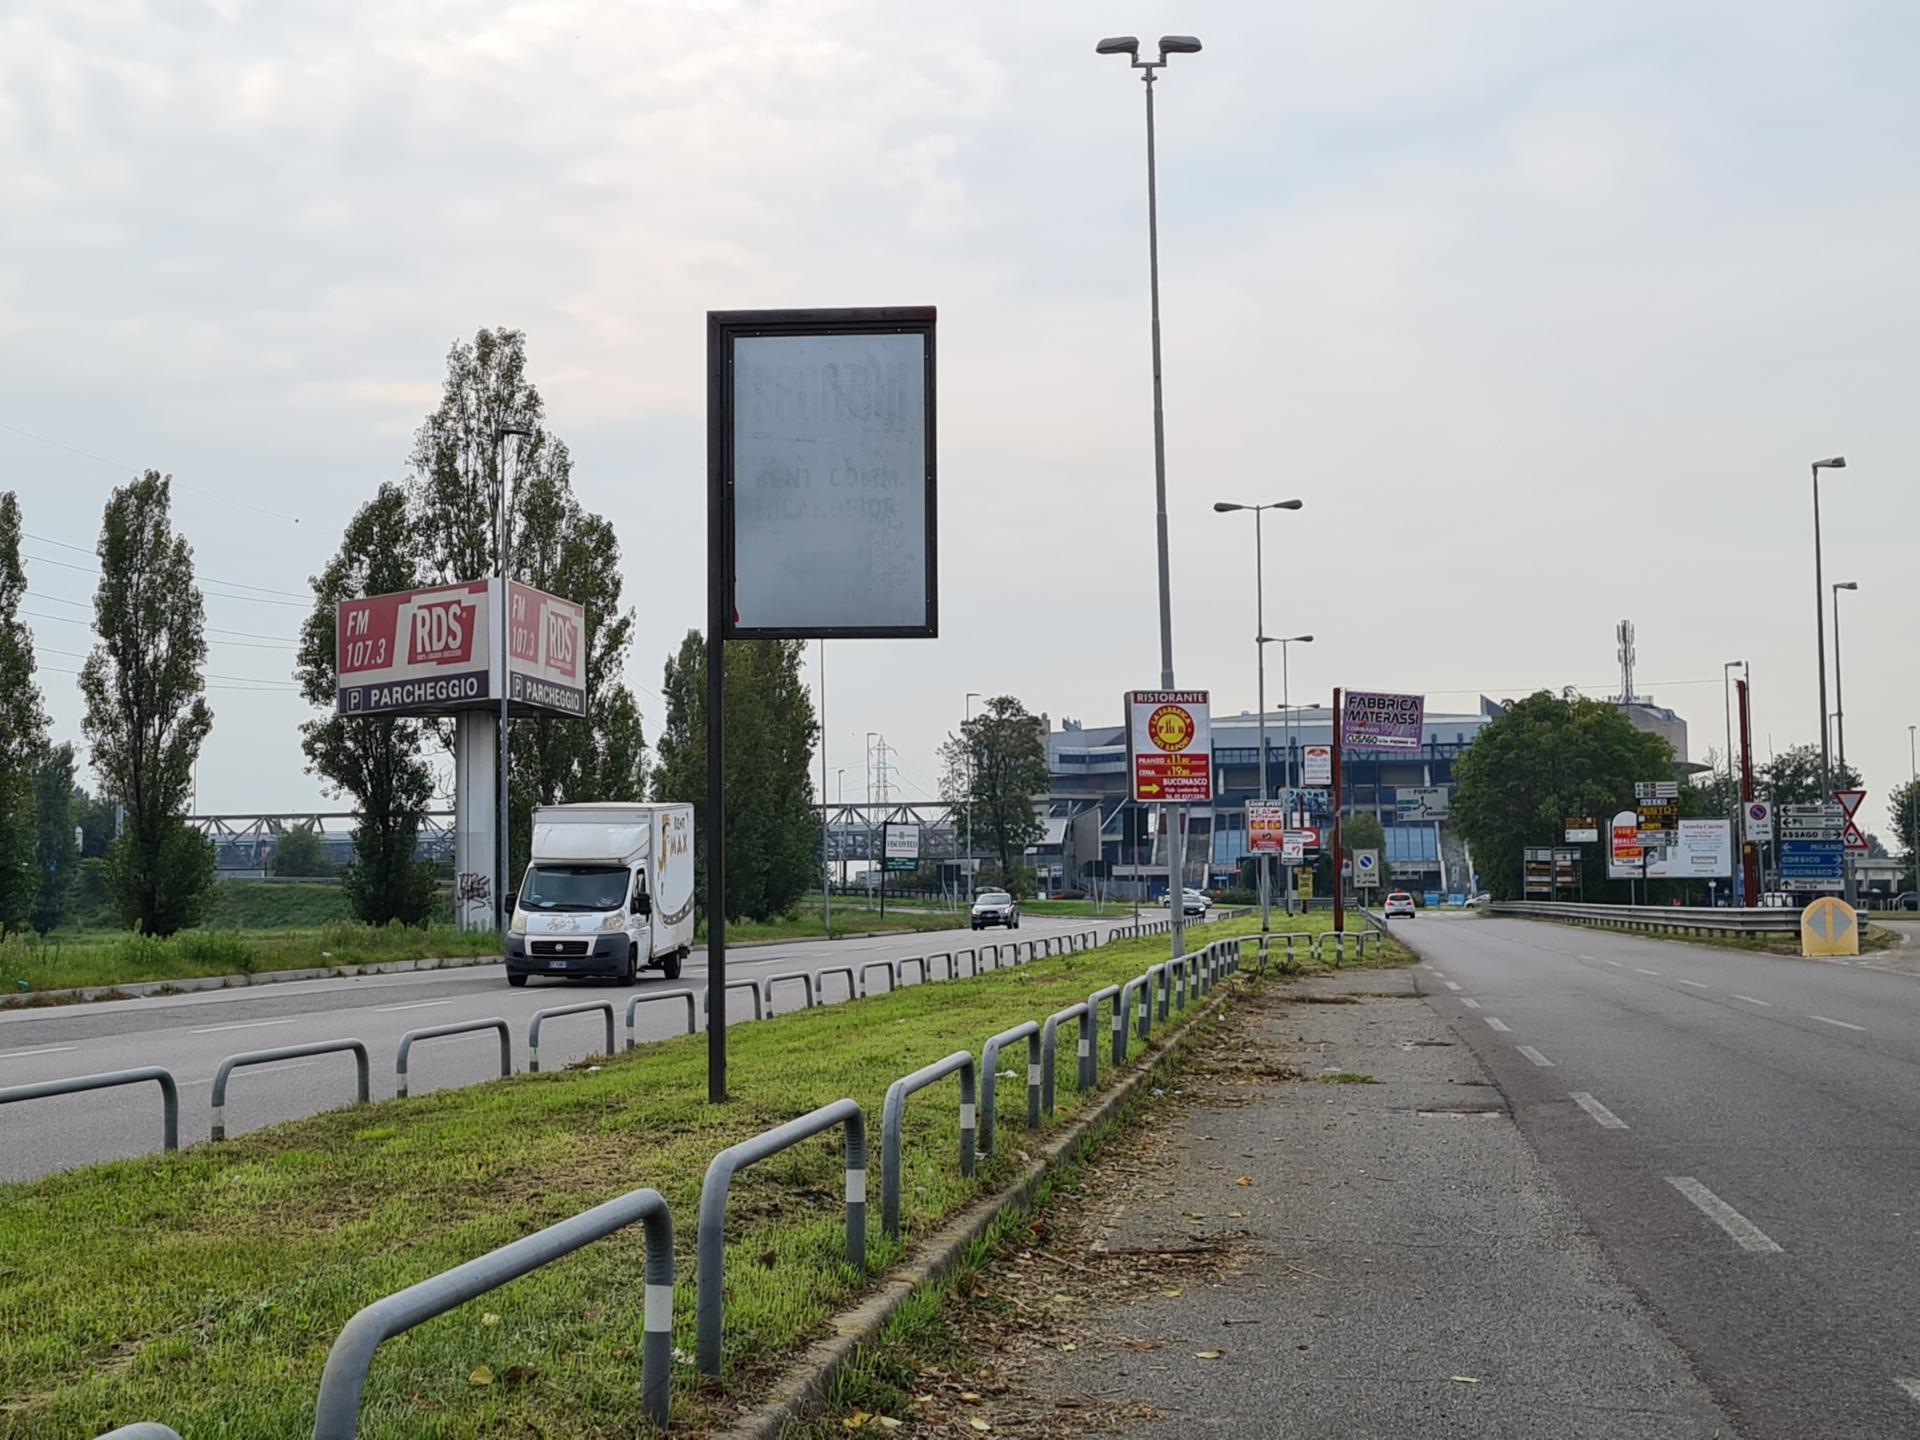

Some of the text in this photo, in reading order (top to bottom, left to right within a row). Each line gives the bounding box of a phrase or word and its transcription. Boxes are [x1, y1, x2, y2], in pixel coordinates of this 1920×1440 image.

[511, 593, 526, 622] FM
[346, 608, 371, 637] FM
[416, 604, 463, 653] RDS
[549, 611, 573, 662] RDS
[346, 637, 387, 668] 107.3
[512, 625, 536, 657] 107.3
[371, 676, 478, 707] PARCHEGGIO
[526, 680, 580, 711] PARCHEGGIO
[1136, 693, 1204, 703] RISTORANTE
[1348, 697, 1419, 711] FABBRICA
[1347, 711, 1419, 725] MATERASSI
[1346, 734, 1378, 745] CUSAGO
[1163, 778, 1208, 786] BUCCINASCO
[1782, 868, 1833, 876] BUCCINASCO
